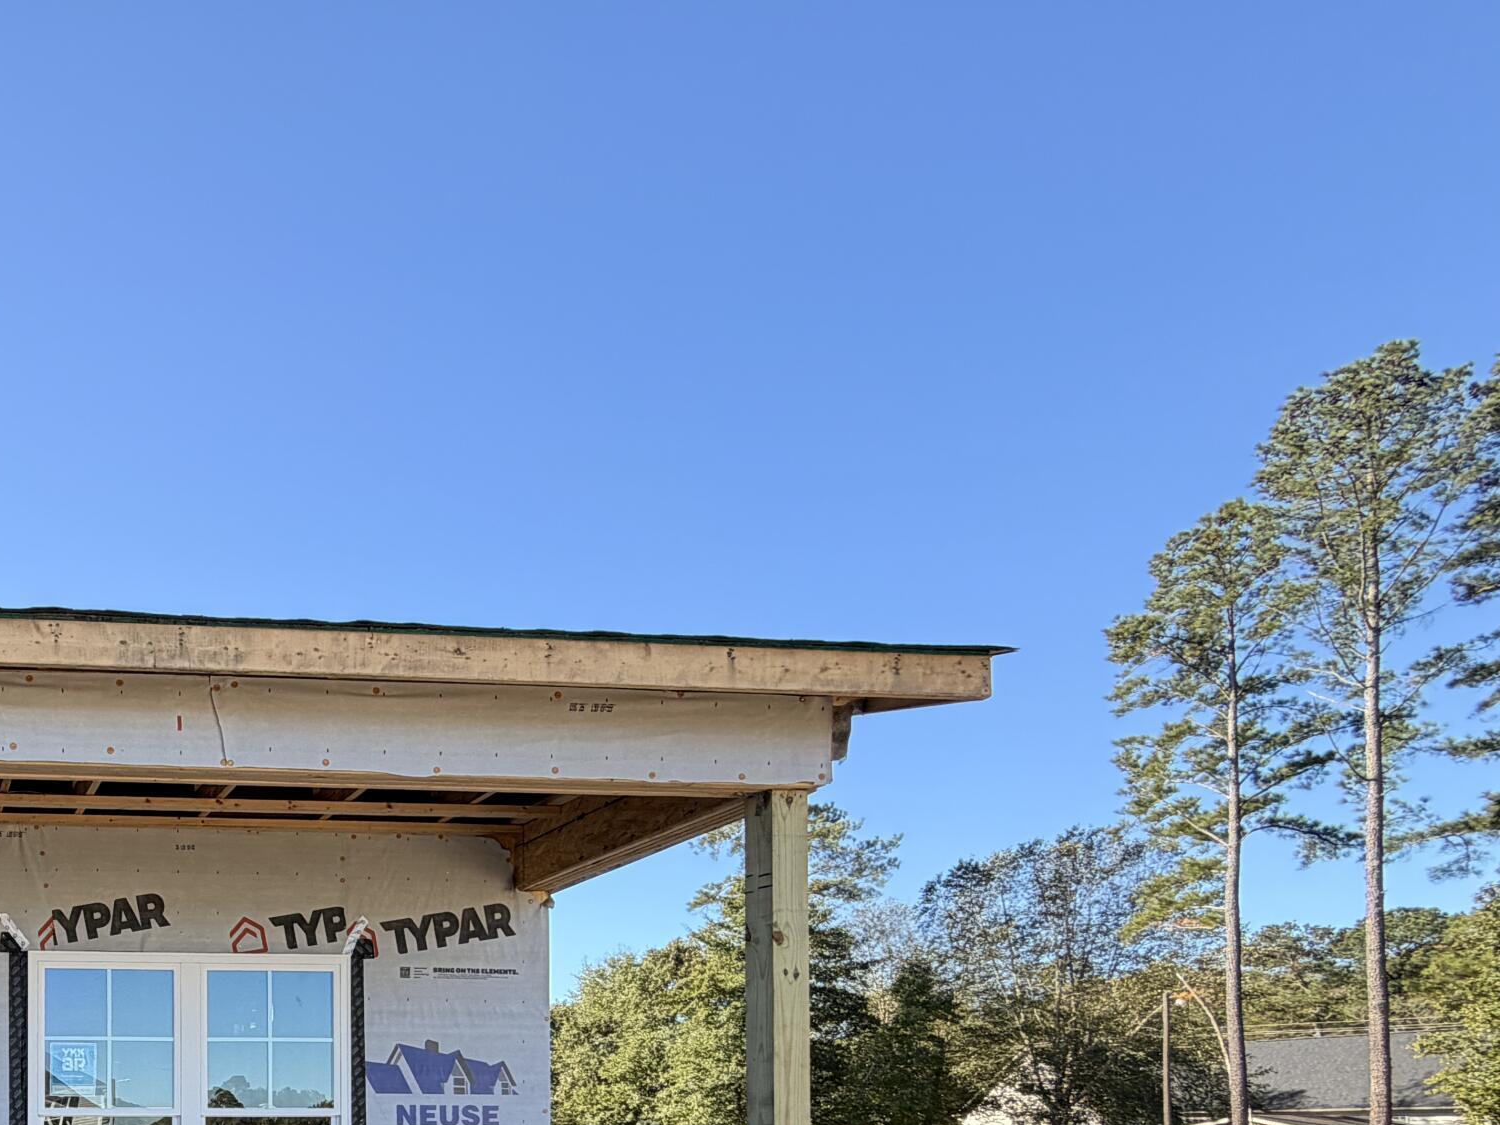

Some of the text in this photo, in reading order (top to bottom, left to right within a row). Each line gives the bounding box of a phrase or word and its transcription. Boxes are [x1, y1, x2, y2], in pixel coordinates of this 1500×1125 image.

[52, 893, 171, 946] YPAR
[379, 903, 517, 954] TYPAR
[62, 1047, 85, 1058] YKK
